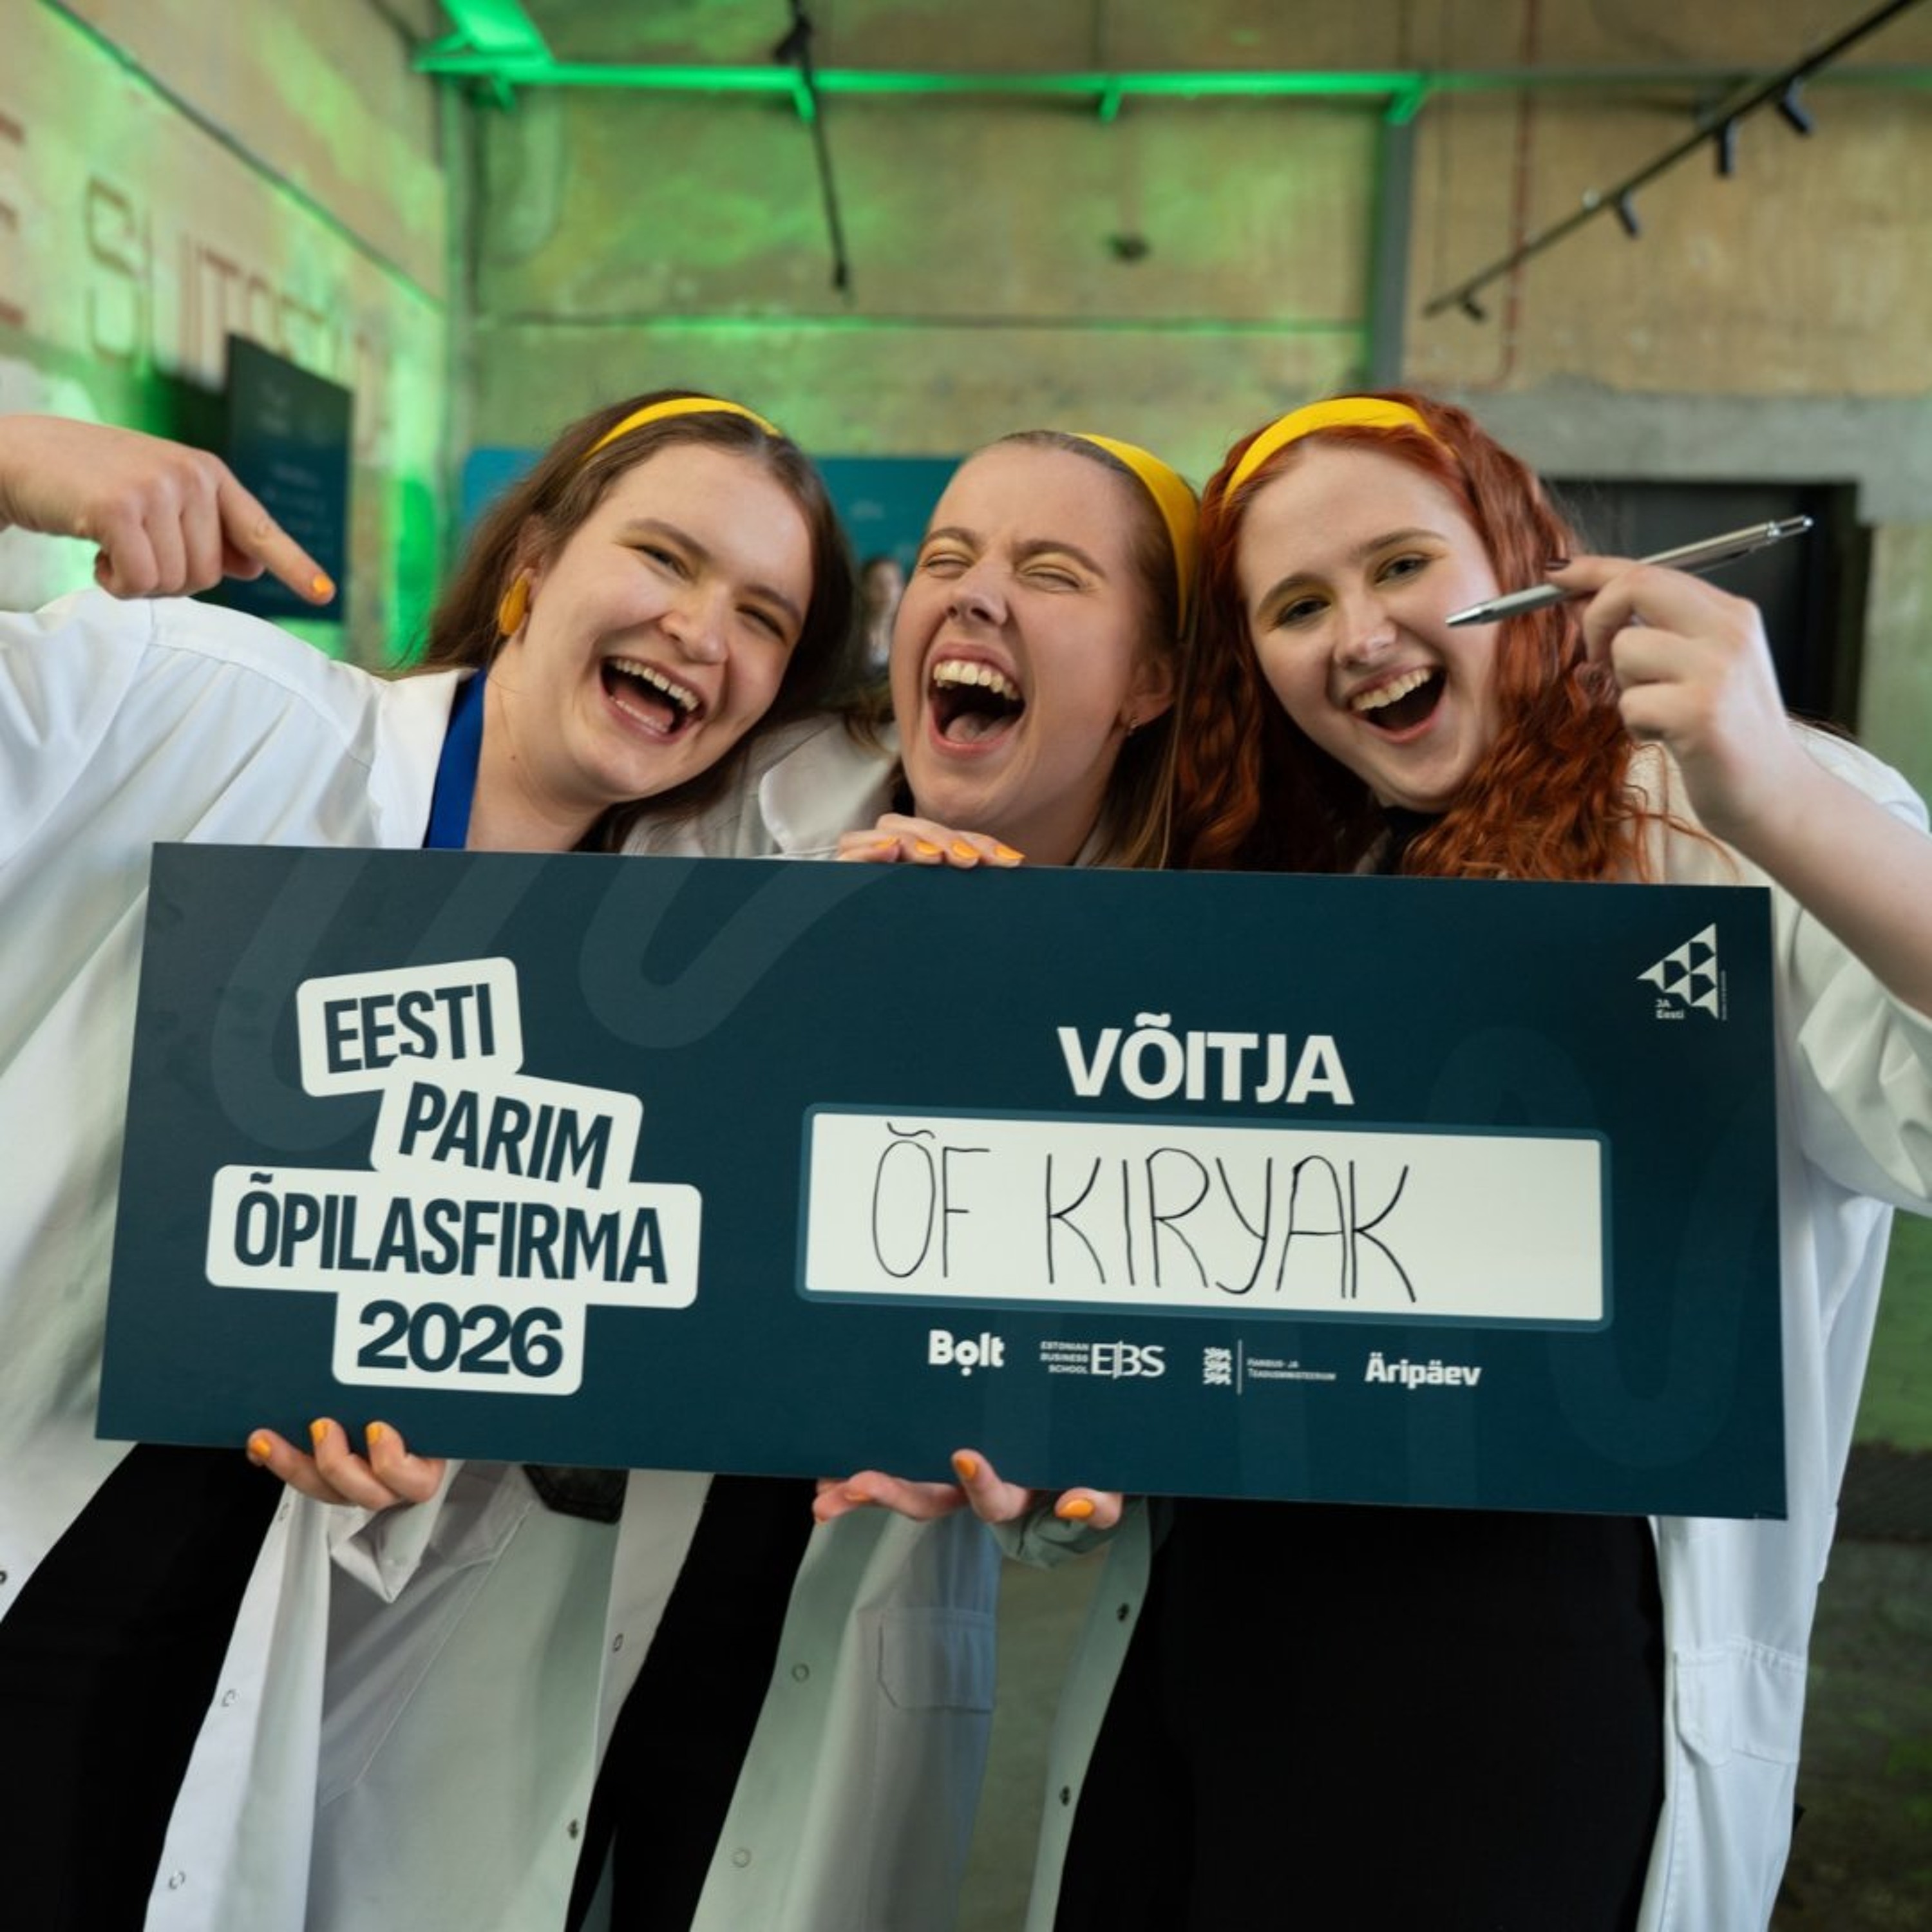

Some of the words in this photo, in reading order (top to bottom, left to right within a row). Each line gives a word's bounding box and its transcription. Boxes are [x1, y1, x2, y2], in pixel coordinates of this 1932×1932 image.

[323, 983, 496, 1074] EESTI
[1057, 1012, 1354, 1105] VÕITJA
[398, 1081, 614, 1190] PARIM
[234, 1171, 668, 1284] ÕPILASFIRMA
[872, 1122, 990, 1278] ÕF
[1046, 1146, 1416, 1303] KIRYAK
[357, 1299, 564, 1378] 2026
[929, 1329, 1005, 1376] Bolt
[1048, 1365, 1088, 1374] SCHOOL
[1091, 1341, 1166, 1379] EBS
[1365, 1352, 1481, 1389] Äripäev
